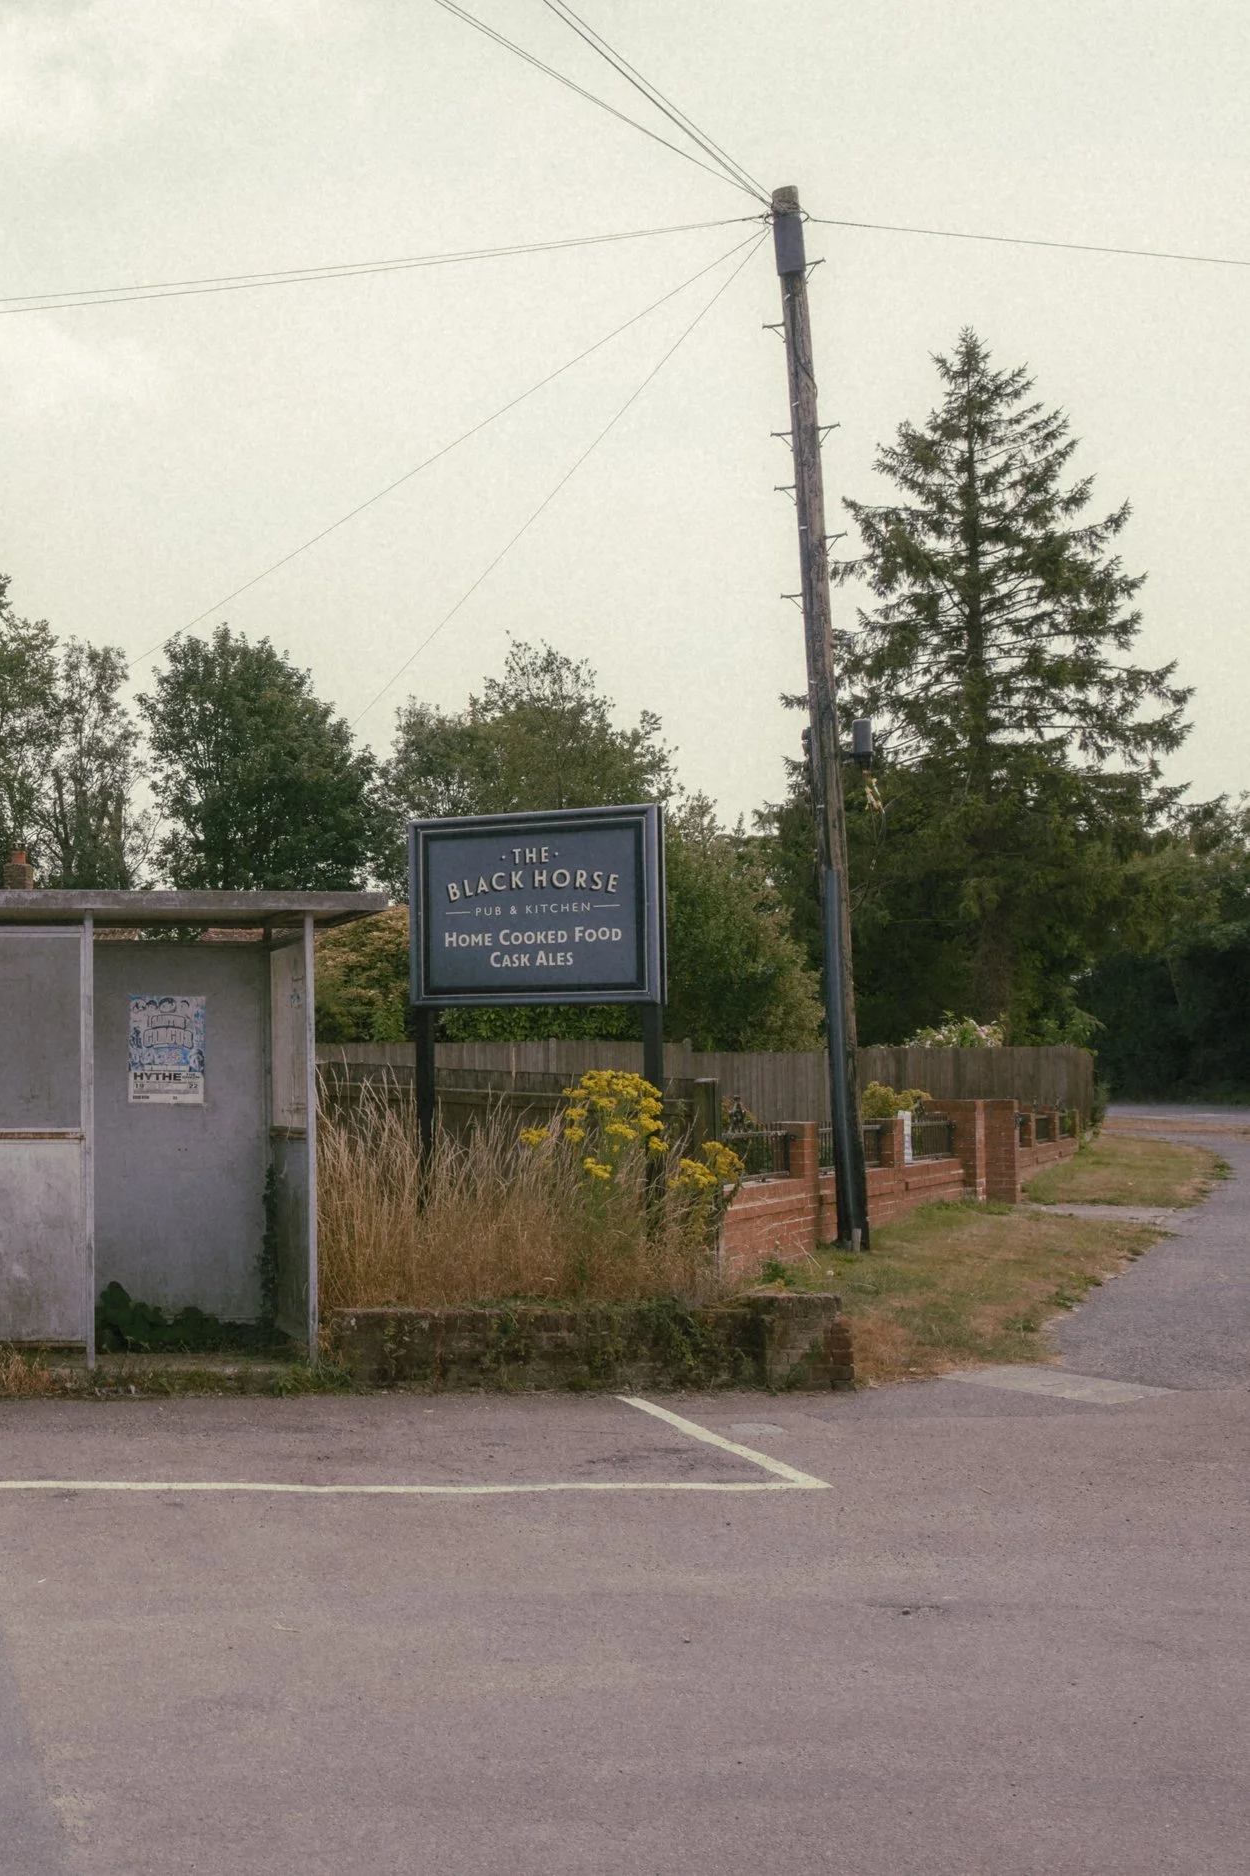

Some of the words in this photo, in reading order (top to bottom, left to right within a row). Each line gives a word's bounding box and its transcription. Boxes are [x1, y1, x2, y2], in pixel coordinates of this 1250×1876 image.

[512, 846, 549, 864] THE
[447, 870, 524, 902] BLACK
[533, 868, 619, 893] HORSE
[475, 906, 502, 917] PUB
[509, 906, 518, 916] &
[525, 902, 591, 915] KITCHEN
[444, 931, 493, 948] HOME
[498, 929, 568, 946] COOKED
[574, 926, 622, 943] FOOD
[490, 951, 531, 968] CASK
[535, 950, 574, 967] ALES
[133, 1072, 182, 1081] HYTHE
